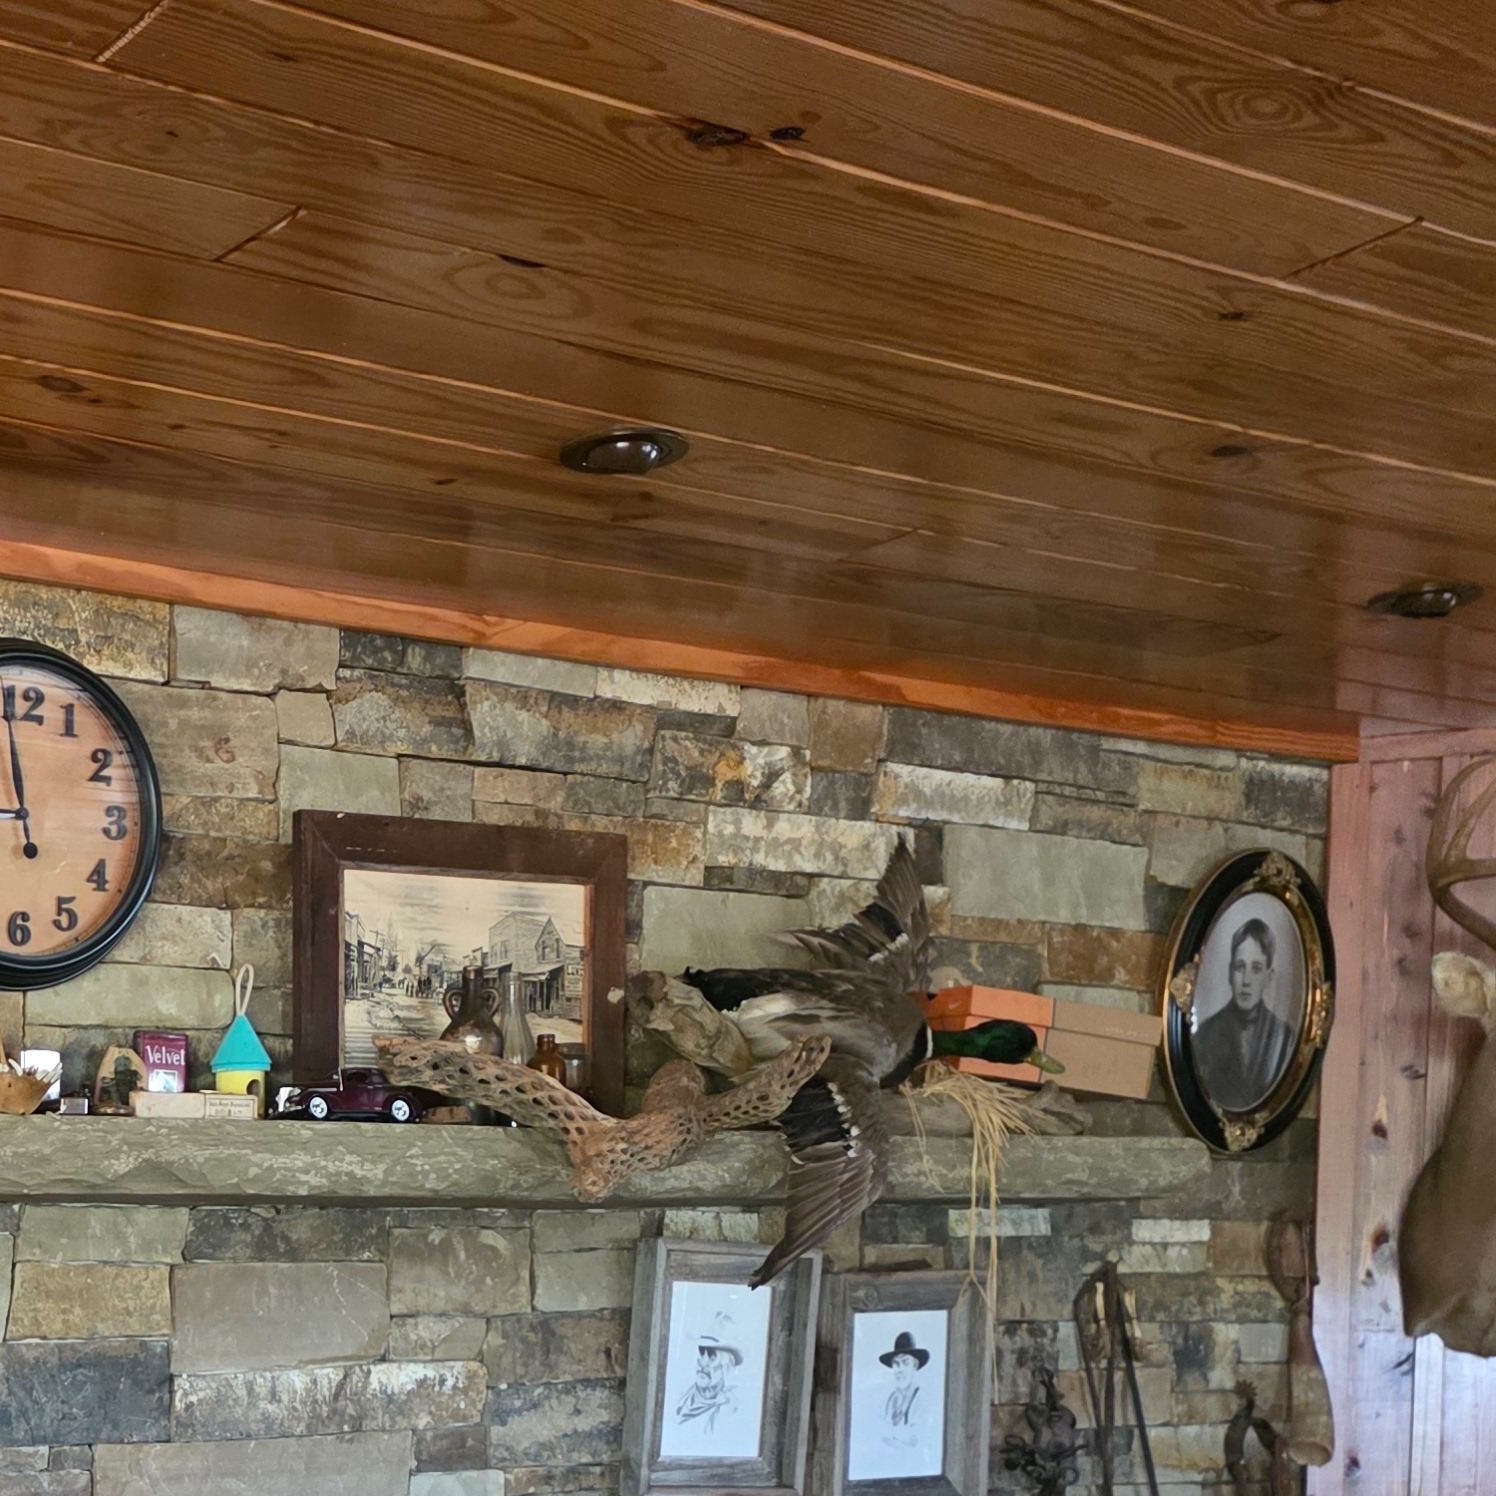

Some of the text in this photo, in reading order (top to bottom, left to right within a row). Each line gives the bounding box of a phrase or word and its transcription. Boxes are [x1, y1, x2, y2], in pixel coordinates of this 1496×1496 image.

[2, 685, 46, 726] 12
[58, 703, 79, 738] 1
[87, 748, 113, 786] 2
[103, 805, 127, 840] 3
[86, 858, 109, 892] 4
[8, 911, 31, 946] 6
[52, 896, 78, 932] 5
[145, 1045, 185, 1066] Velvet
